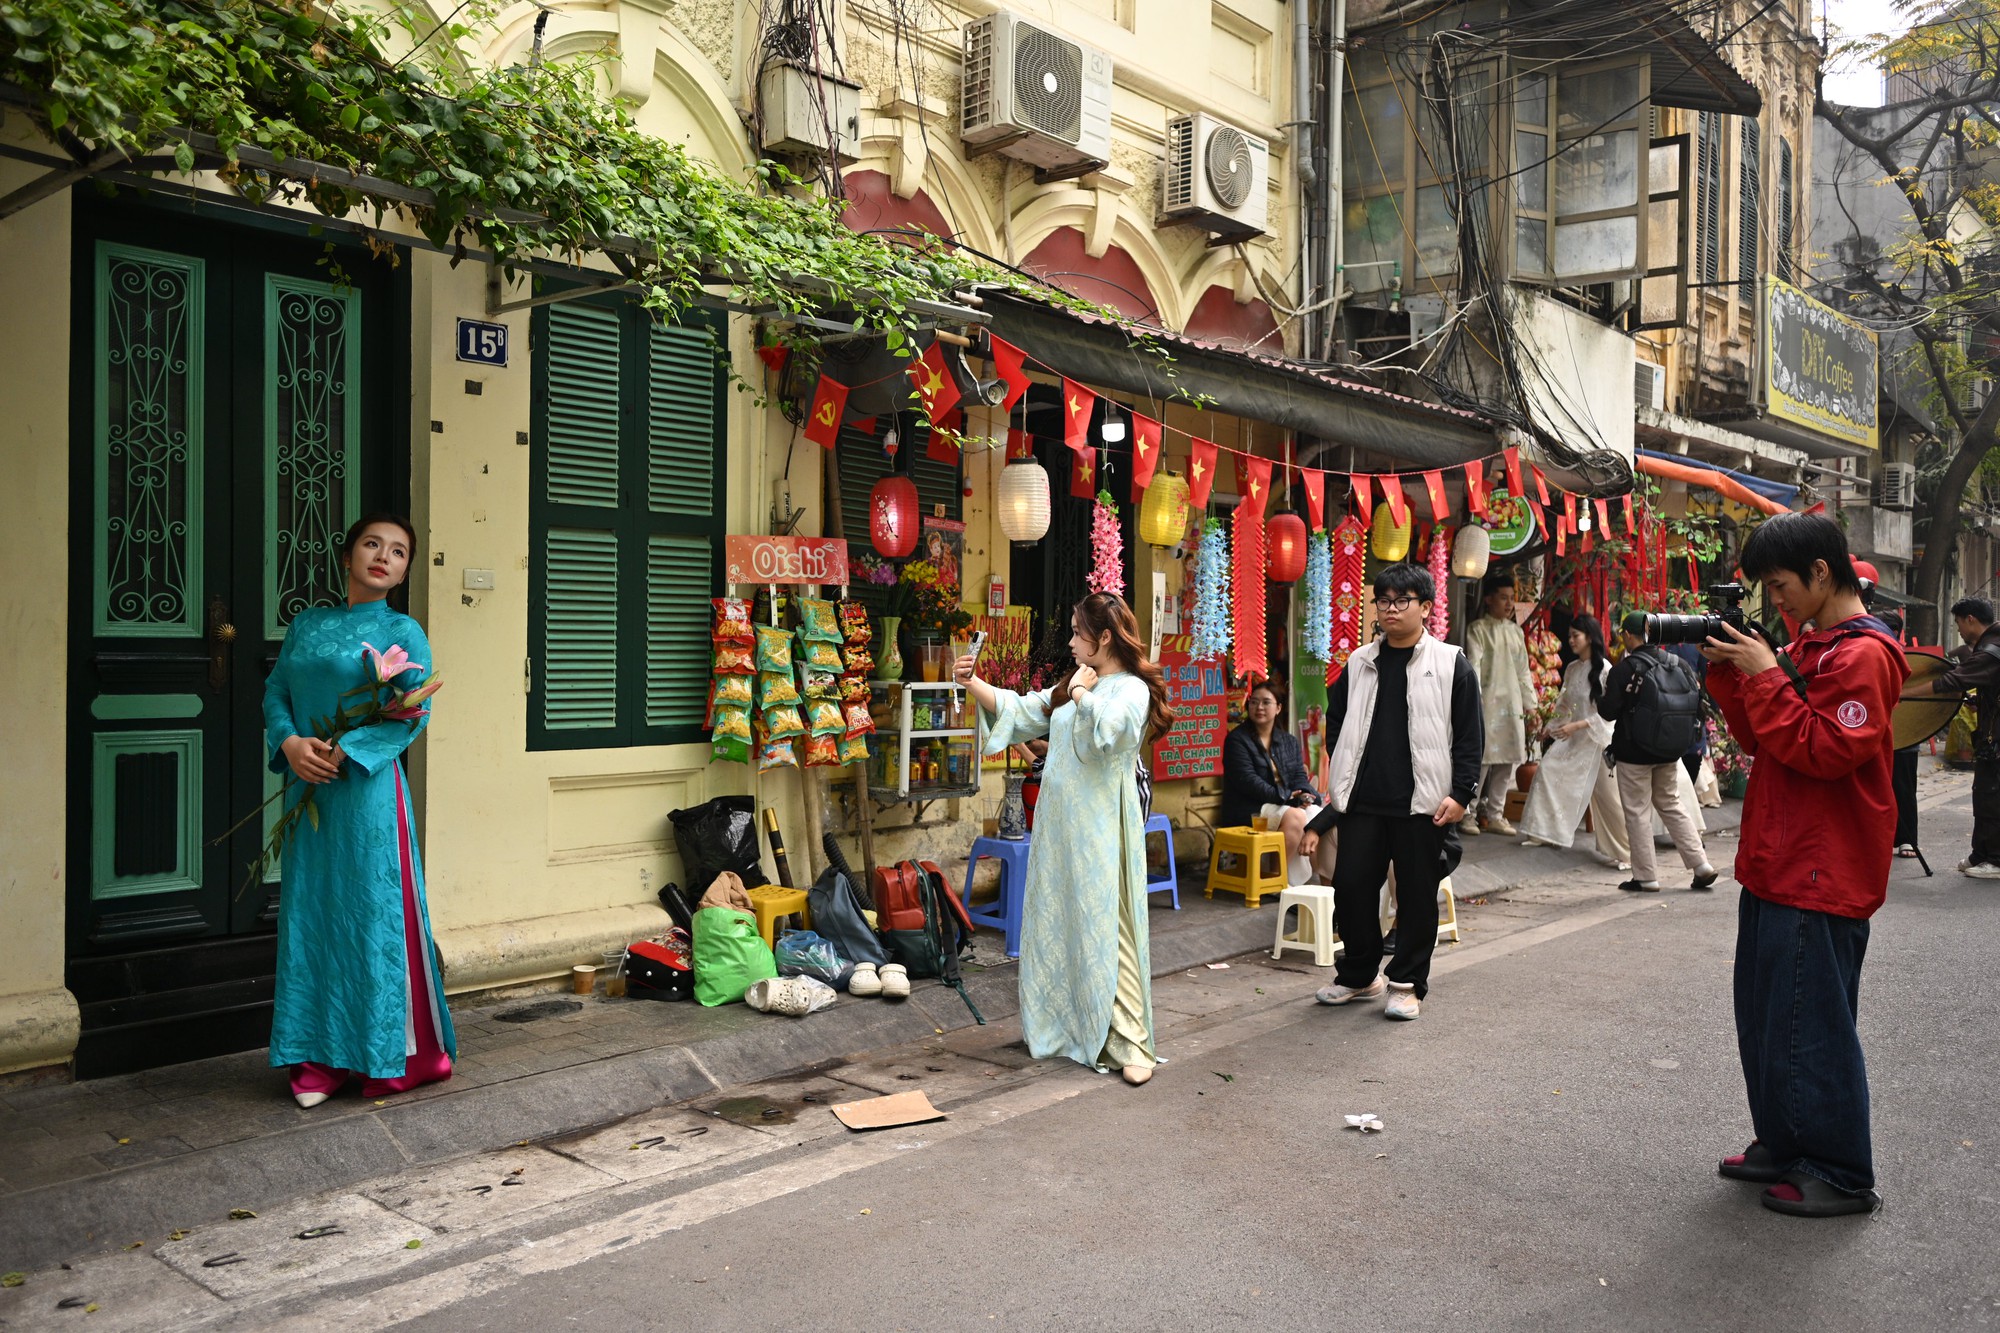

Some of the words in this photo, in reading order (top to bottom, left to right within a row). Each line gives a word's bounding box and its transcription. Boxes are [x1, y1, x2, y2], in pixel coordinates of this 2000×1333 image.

[1825, 355, 1853, 393] Coffee
[752, 543, 827, 578] Oishi
[1301, 664, 1319, 676] 0368
[1205, 662, 1224, 696] ĐÁ
[1181, 682, 1201, 701] ĐÀO
[1194, 704, 1218, 717] CAM
[1199, 718, 1220, 731] LEO
[1167, 732, 1189, 747] TRÀ
[1160, 747, 1181, 763] TRÀ
[1183, 747, 1220, 760] CHANH
[1167, 762, 1190, 777] BỘT
